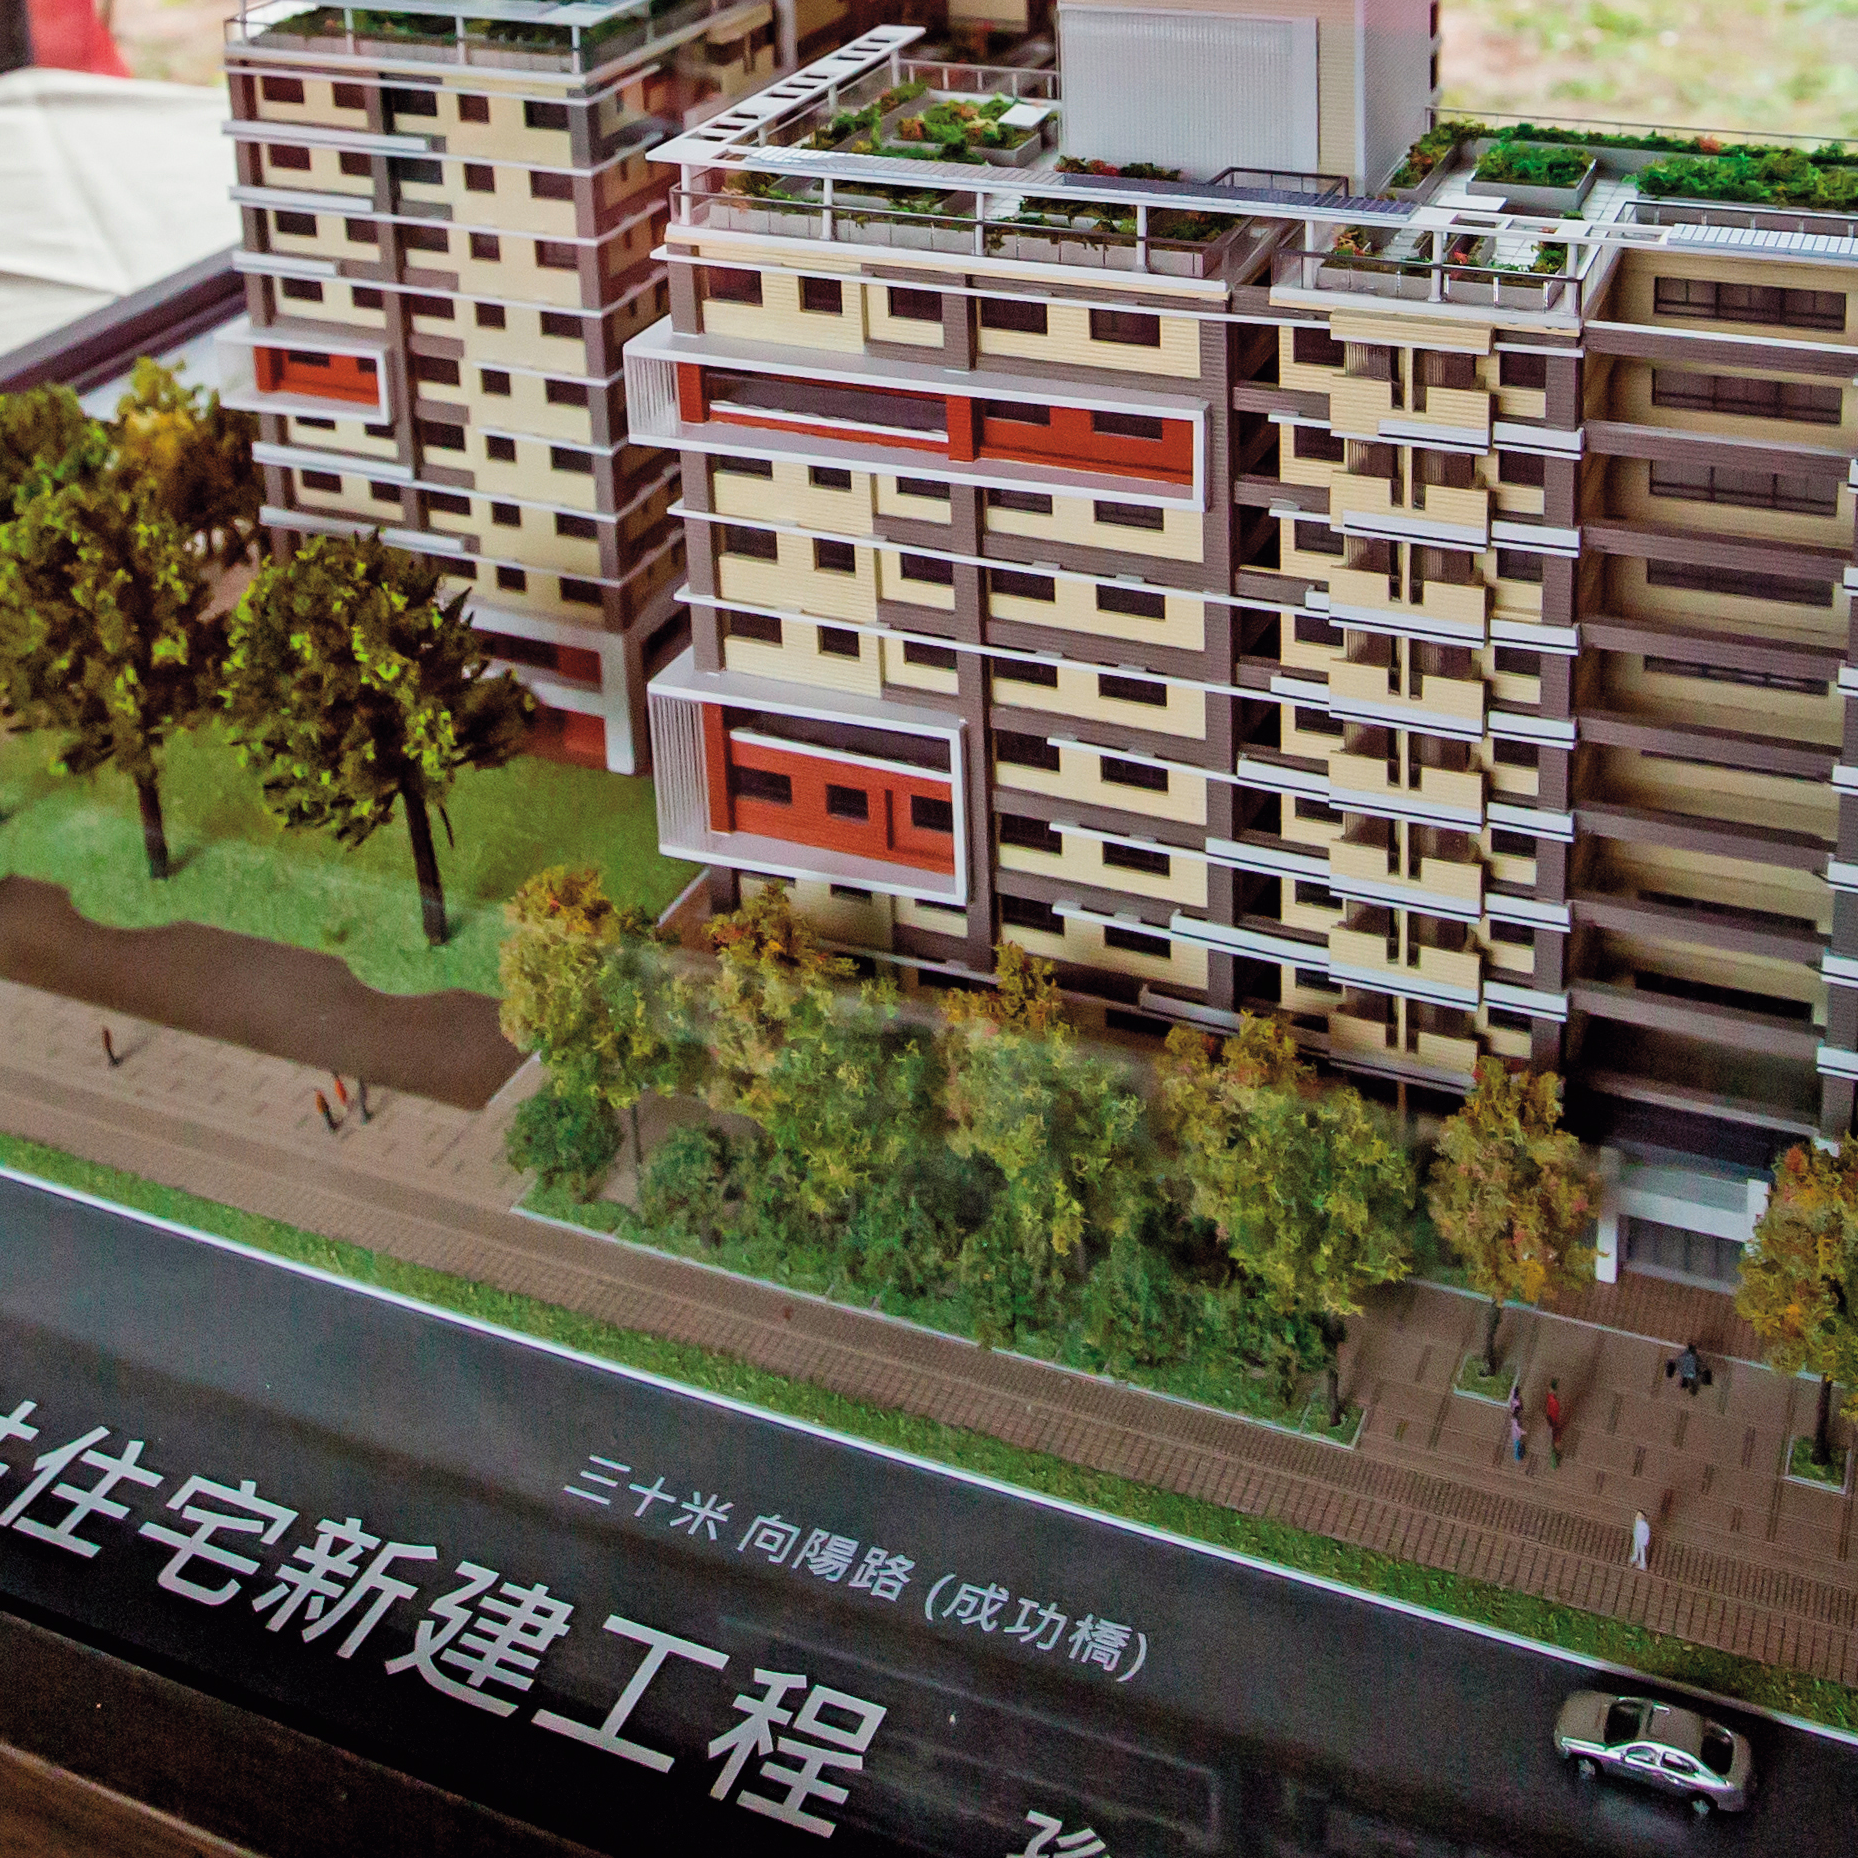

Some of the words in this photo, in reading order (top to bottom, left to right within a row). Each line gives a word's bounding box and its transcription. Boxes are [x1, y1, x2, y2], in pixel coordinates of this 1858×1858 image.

[563, 1454, 735, 1541] 三十米
[738, 1513, 917, 1603] 向陽路
[923, 1573, 1149, 1682] (成功橋)
